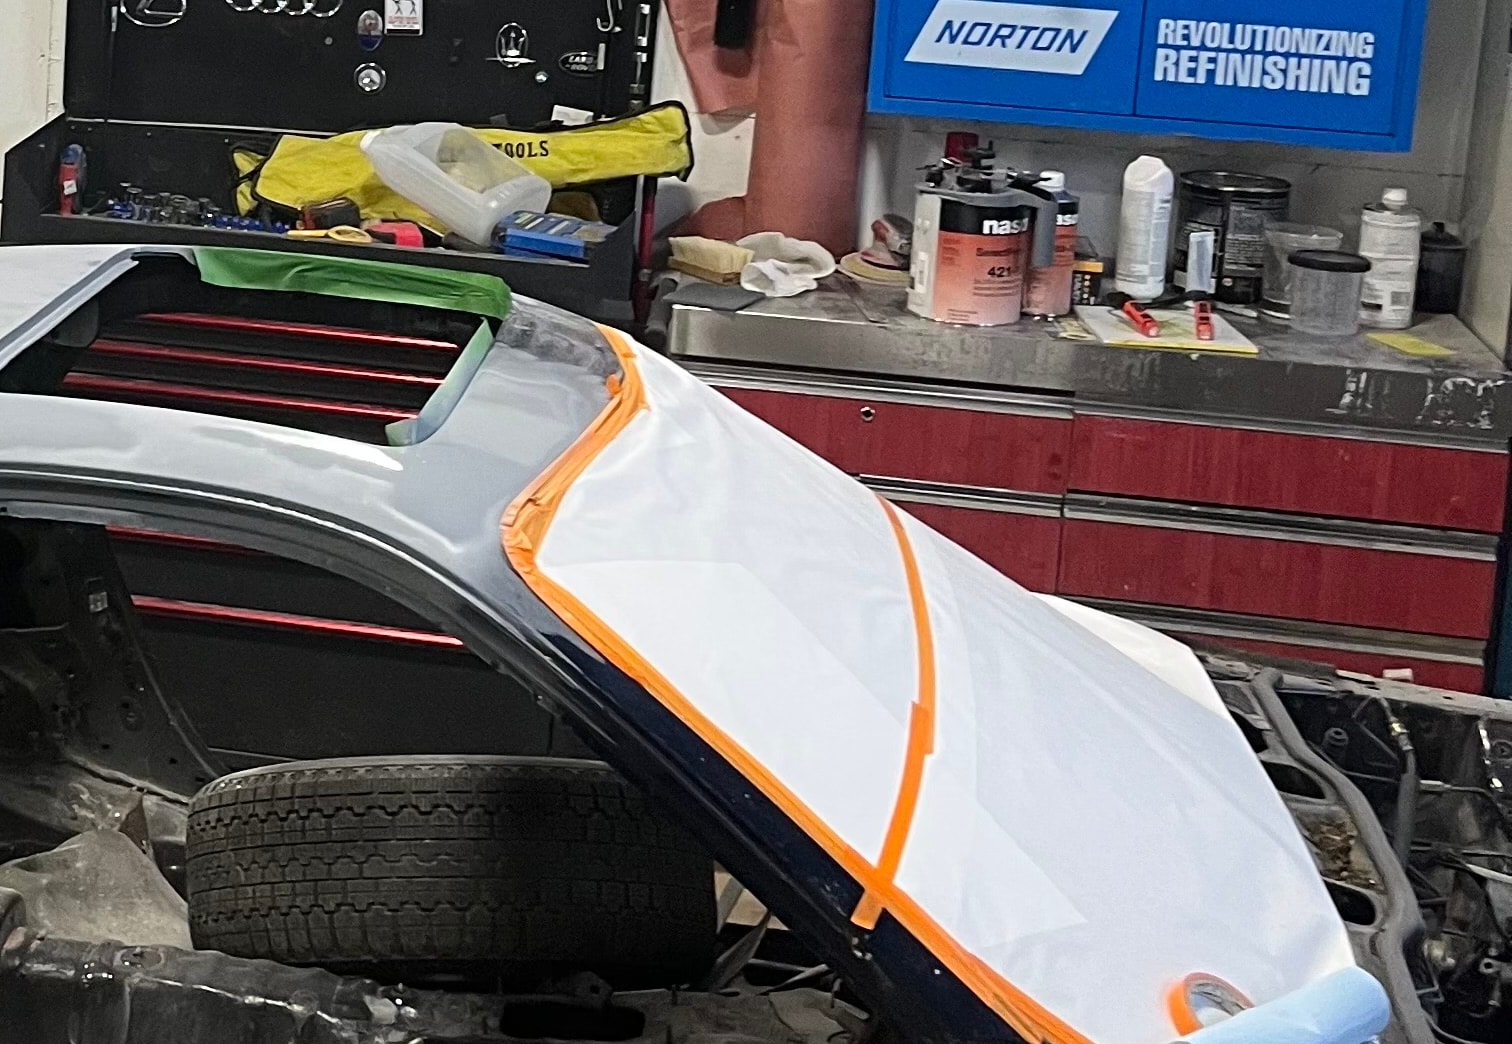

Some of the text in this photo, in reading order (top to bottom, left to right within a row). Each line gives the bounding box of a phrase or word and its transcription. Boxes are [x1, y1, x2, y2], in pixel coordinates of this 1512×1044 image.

[935, 20, 1089, 53] NORTON
[1157, 18, 1375, 59] REVOLUTIONIZING
[1154, 48, 1372, 96] REFINISHING
